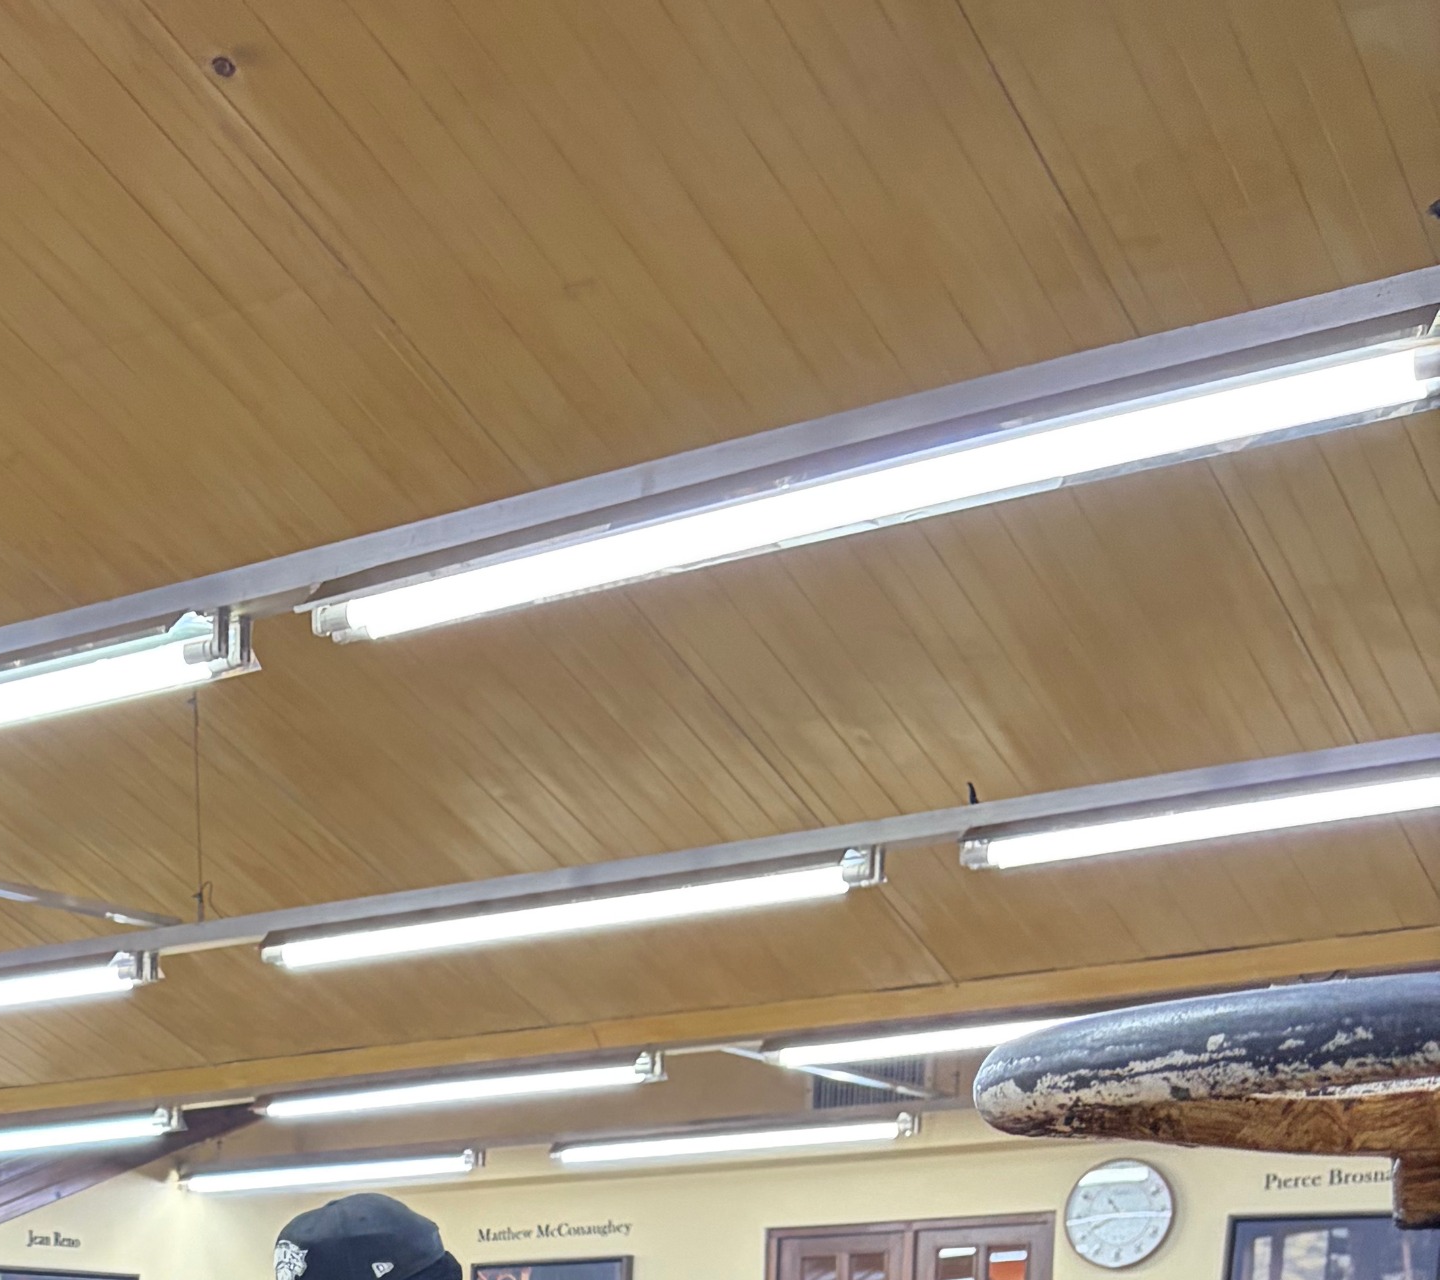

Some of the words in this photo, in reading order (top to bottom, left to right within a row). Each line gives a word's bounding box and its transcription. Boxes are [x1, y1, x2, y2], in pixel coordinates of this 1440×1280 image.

[1264, 1172, 1322, 1190] Pierce
[1328, 1167, 1393, 1186] Brosna
[26, 1229, 51, 1247] Jean
[477, 1227, 533, 1243] Matthew
[536, 1219, 632, 1239] McConaughey
